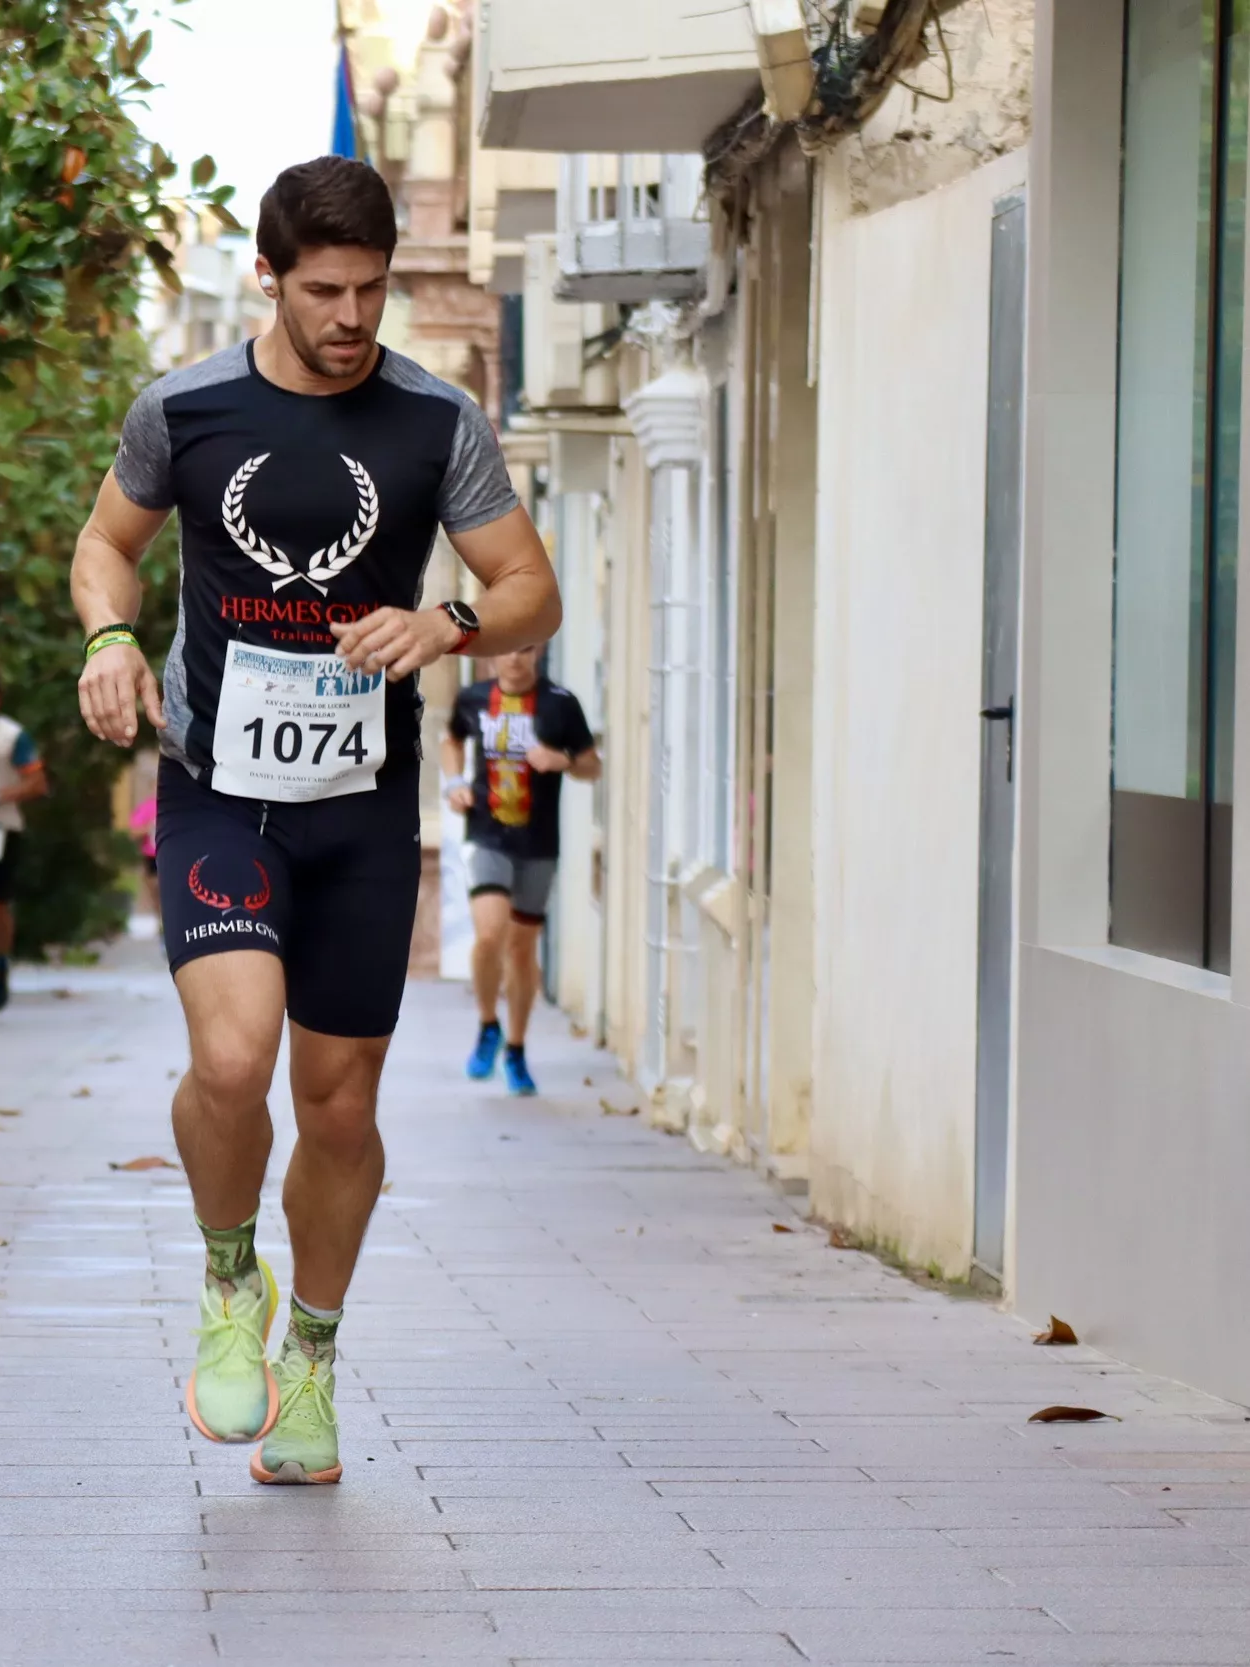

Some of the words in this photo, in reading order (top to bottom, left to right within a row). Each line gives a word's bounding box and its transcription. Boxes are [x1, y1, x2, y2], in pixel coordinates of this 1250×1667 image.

[221, 596, 321, 625] HERMES
[271, 629, 333, 644] Training
[243, 717, 368, 766] 1074
[185, 920, 253, 943] HERMES
